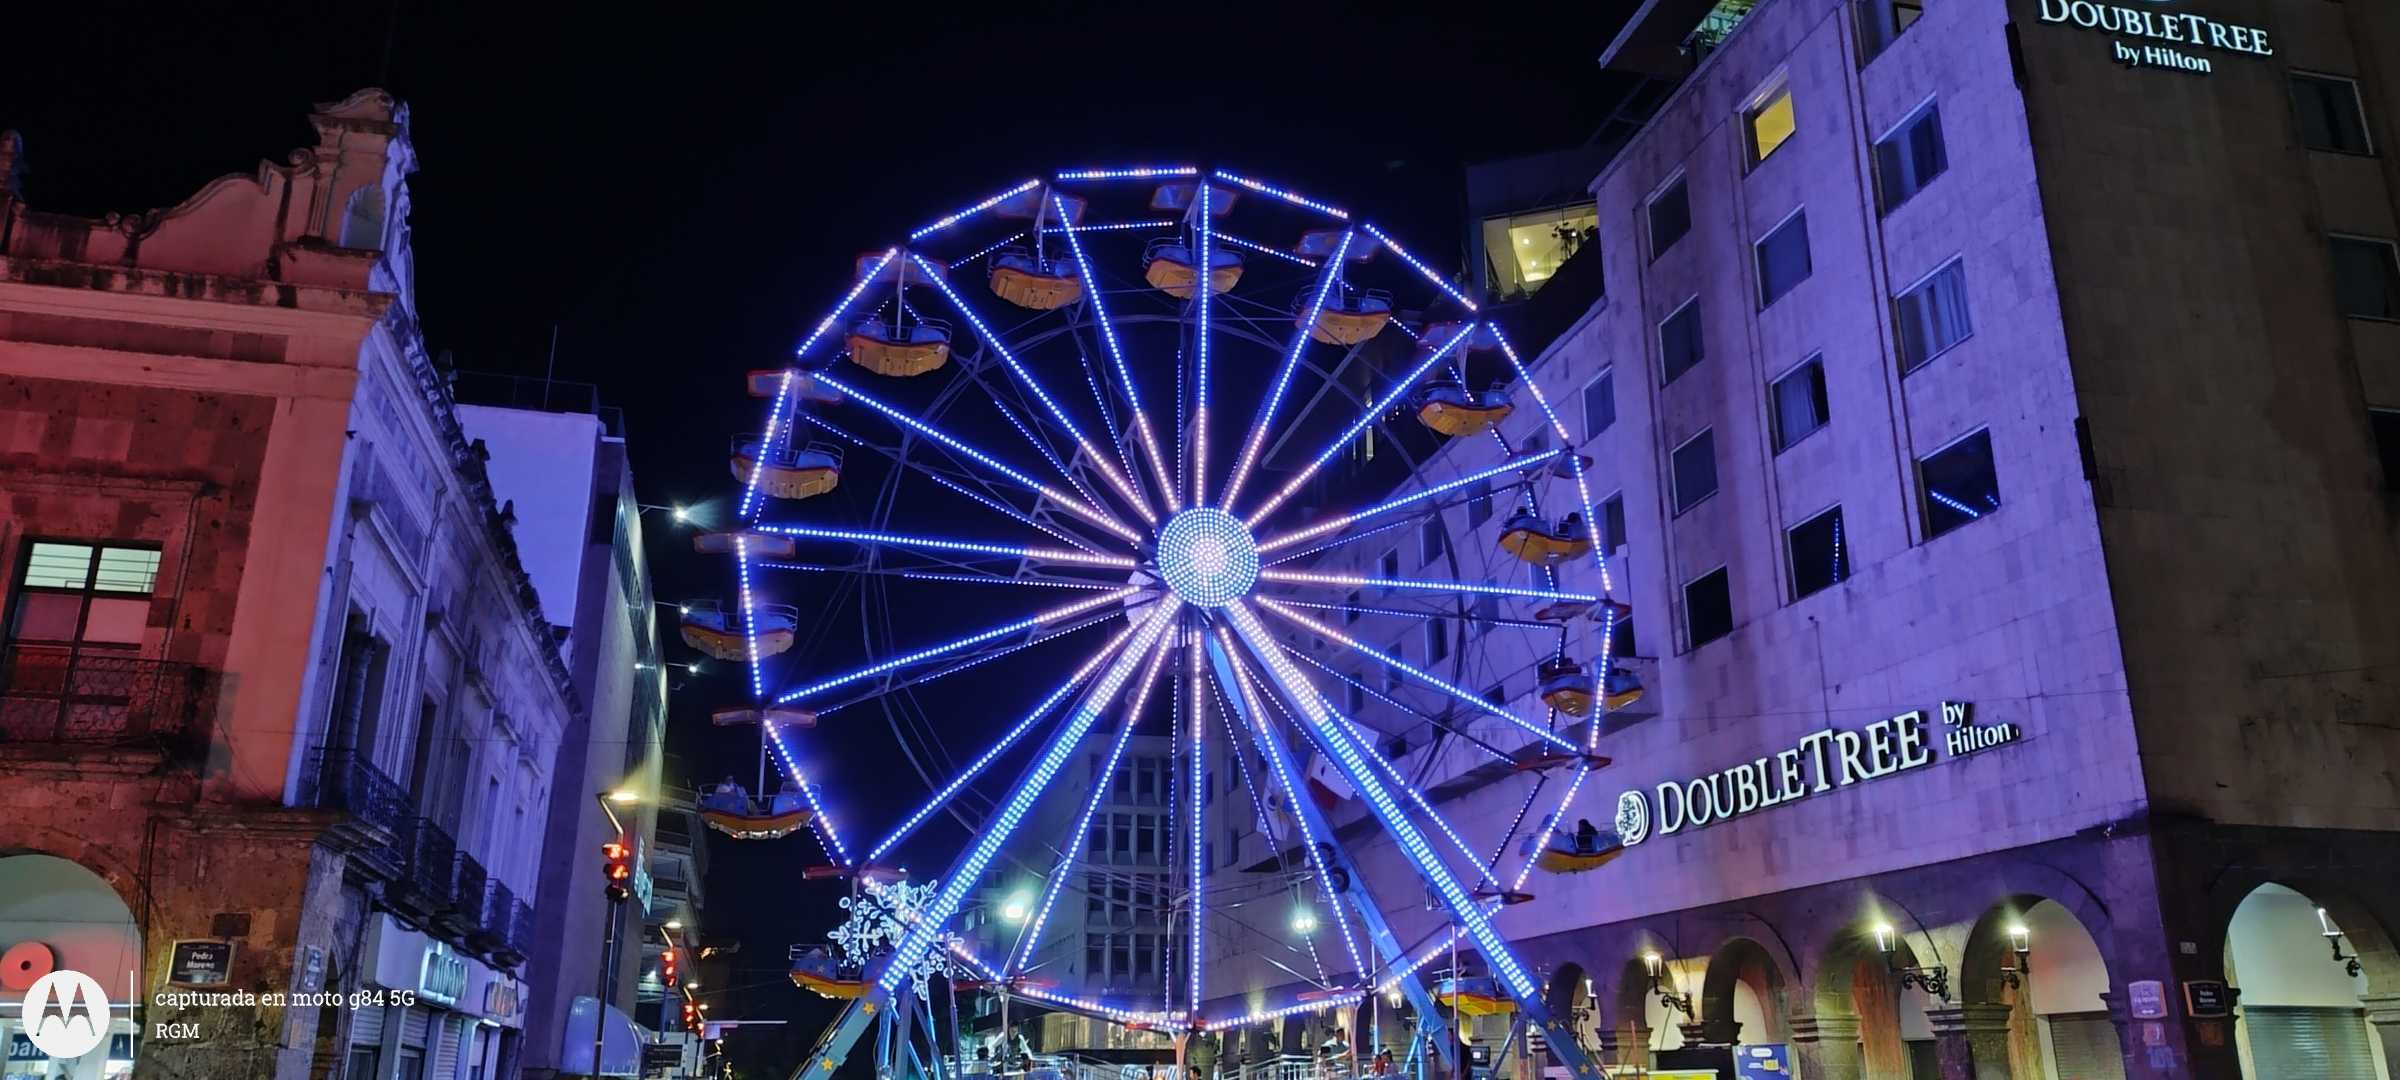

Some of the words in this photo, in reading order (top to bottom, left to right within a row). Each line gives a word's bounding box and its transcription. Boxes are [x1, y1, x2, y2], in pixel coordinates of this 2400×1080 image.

[2115, 41, 2141, 66] by
[2144, 46, 2212, 73] Hilton
[1942, 700, 1965, 727] by
[1945, 722, 2012, 756] Hilton
